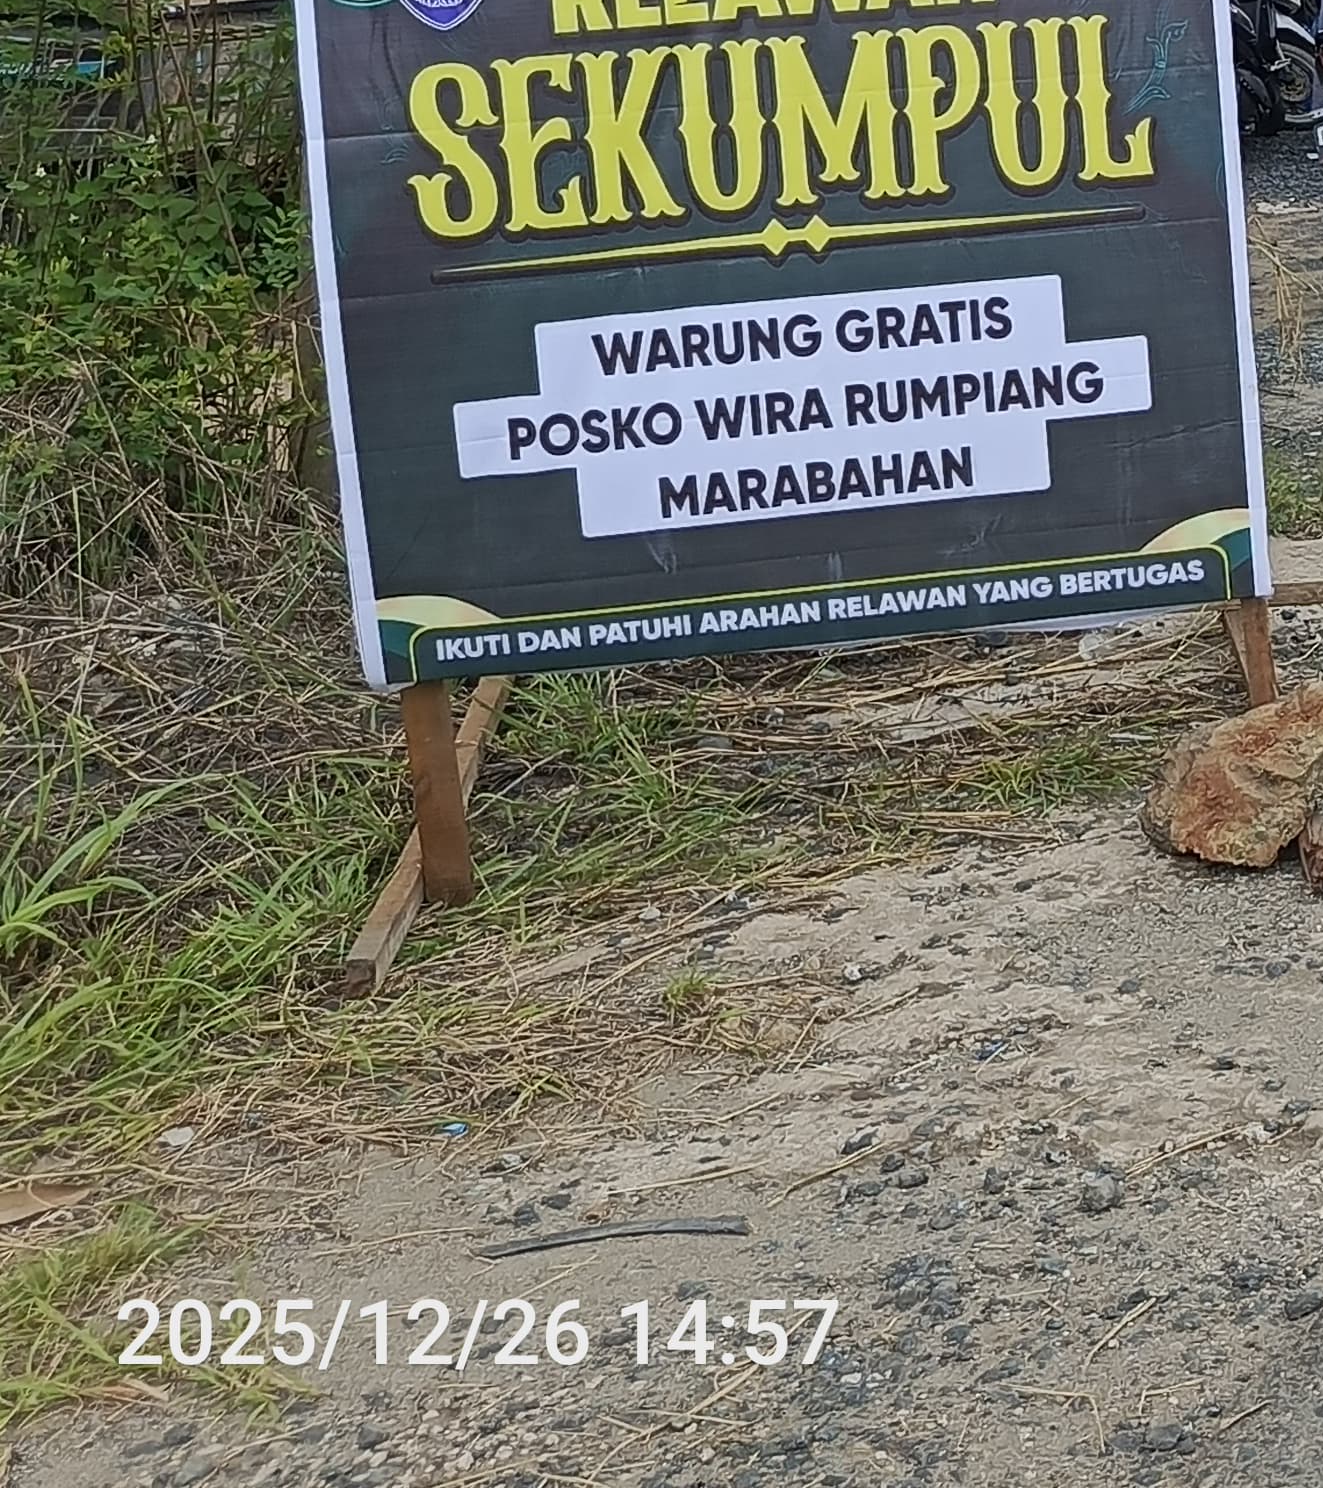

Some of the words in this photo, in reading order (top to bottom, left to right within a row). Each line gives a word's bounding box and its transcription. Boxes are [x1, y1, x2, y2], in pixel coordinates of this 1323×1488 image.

[407, 15, 1154, 238] SEKUMPUL
[591, 315, 822, 376] WARUNG
[836, 296, 1012, 352] GRATIS
[507, 402, 682, 460] POSKO
[694, 387, 840, 442] WIRA
[844, 361, 1105, 426] RUMPIANG
[658, 446, 974, 518] MARABAHAN
[435, 633, 511, 661] IKUTI
[518, 626, 582, 654] DAN
[588, 614, 692, 646] PATUHI
[698, 600, 820, 634] ARAHAN
[828, 585, 968, 621] RELAWAN
[972, 576, 1054, 605] YANG
[1059, 559, 1205, 596] BERTUGAS
